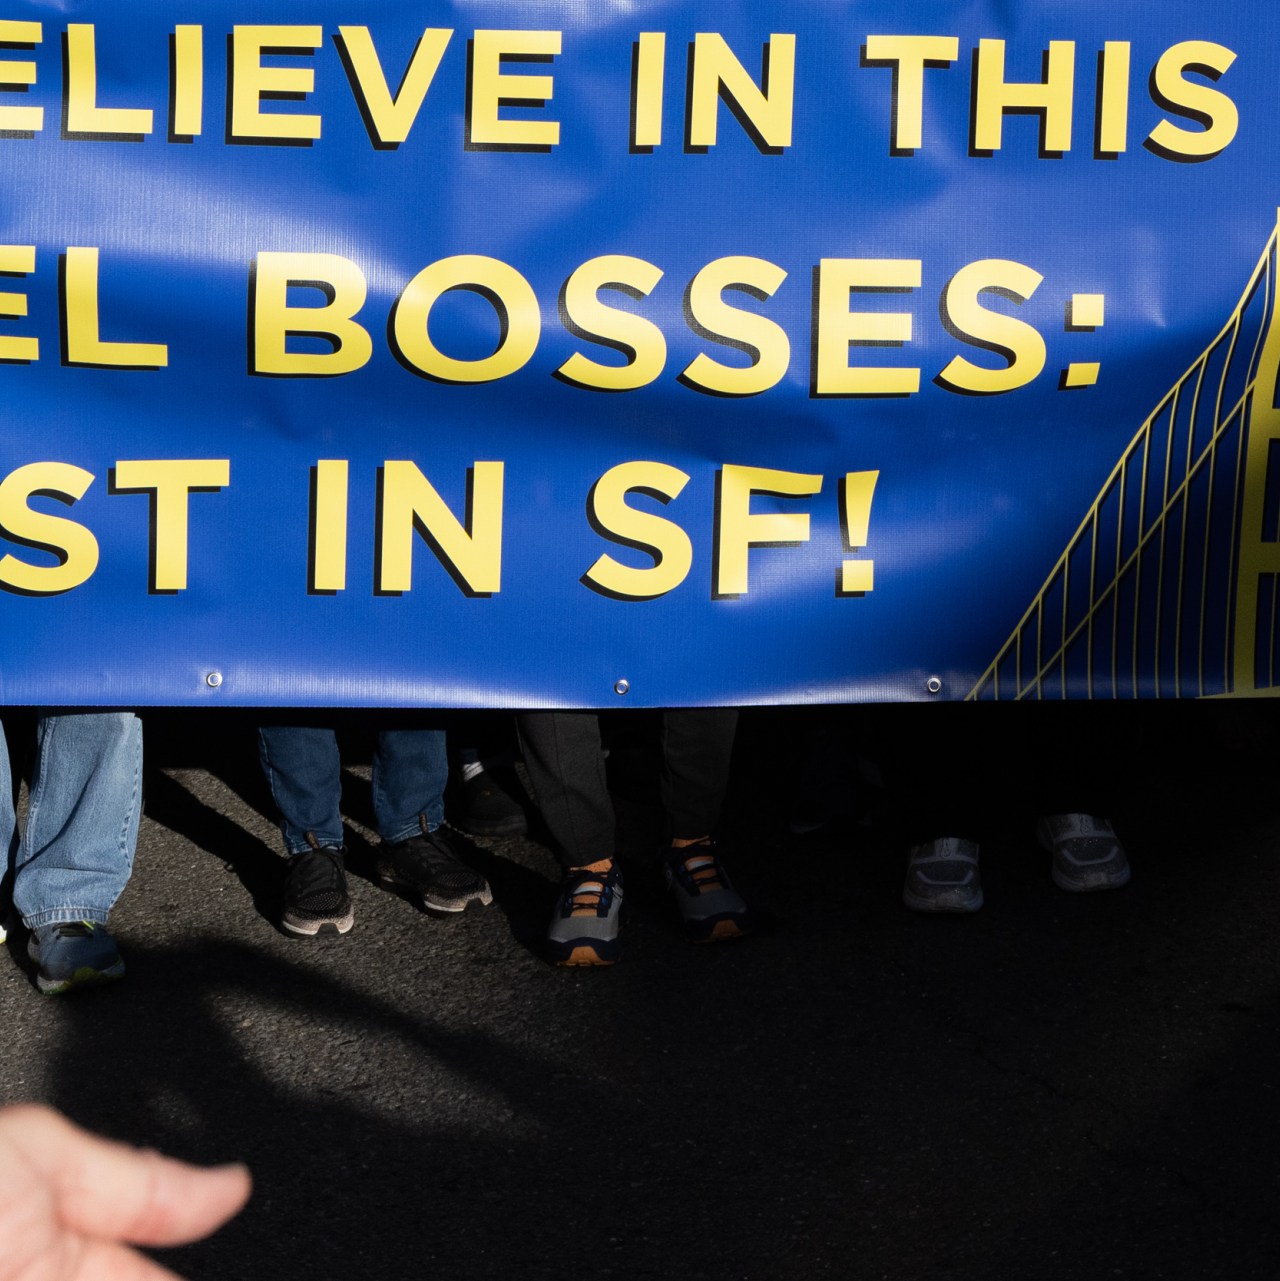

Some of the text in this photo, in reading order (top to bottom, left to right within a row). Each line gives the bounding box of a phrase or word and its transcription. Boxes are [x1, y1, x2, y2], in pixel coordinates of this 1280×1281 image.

[631, 32, 796, 150] IN
[862, 36, 1239, 156] THIS
[253, 252, 1104, 395] BOSSES:
[310, 459, 504, 595] IN
[585, 460, 880, 598] SF!
